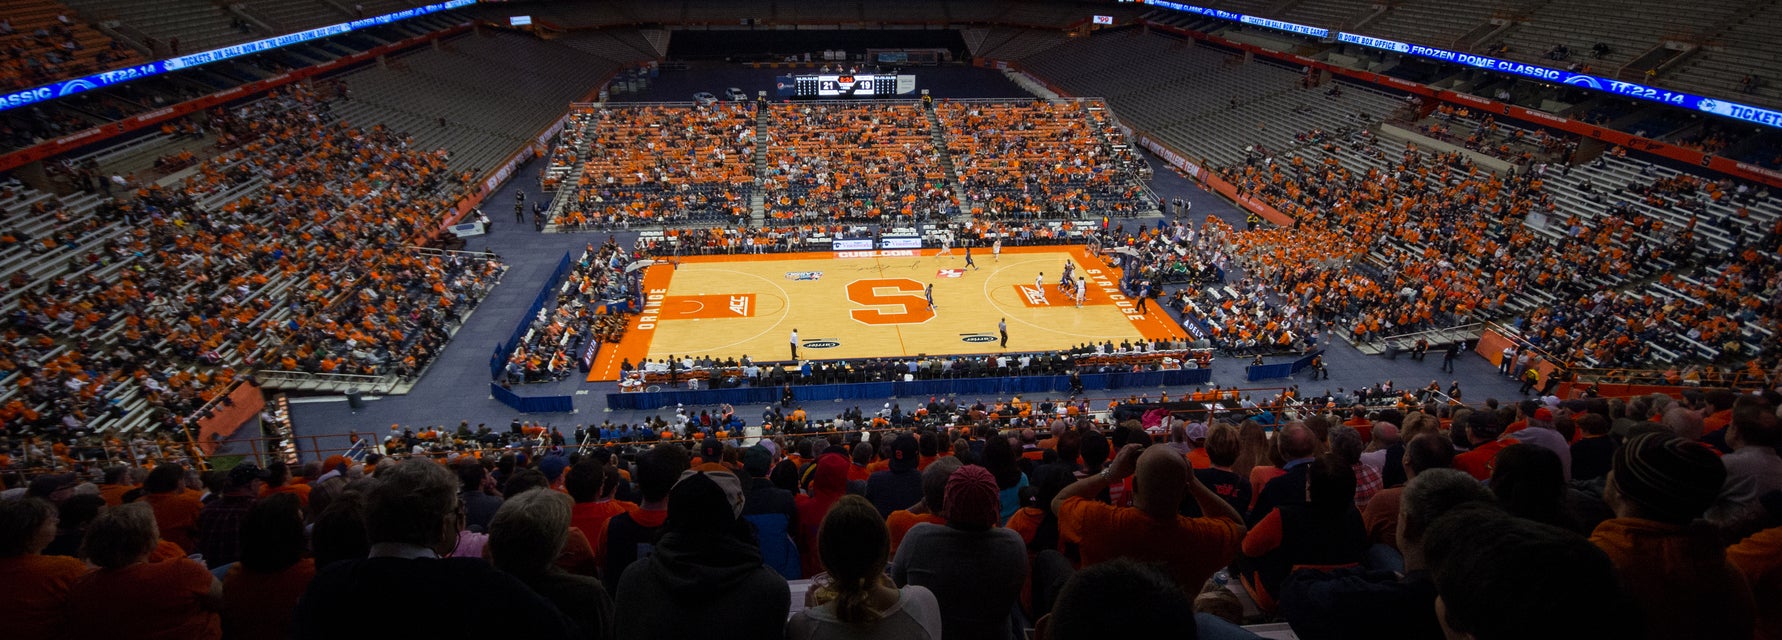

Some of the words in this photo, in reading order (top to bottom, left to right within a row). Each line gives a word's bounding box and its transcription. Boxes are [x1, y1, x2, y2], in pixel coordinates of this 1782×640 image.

[1344, 34, 1360, 43] DOME
[1361, 36, 1373, 45] BOX
[1375, 39, 1396, 50] OFFICE
[181, 52, 212, 66] TICKETS
[213, 50, 223, 60] ON
[224, 47, 241, 59] SALE
[1412, 45, 1456, 61] FROZEN
[1458, 54, 1495, 68] DOME
[1498, 61, 1560, 80] CLASSIC
[100, 64, 157, 85] 11.22.14
[823, 81, 834, 90] 21
[860, 81, 870, 90] 19
[1610, 81, 1685, 104] 11.22.14
[1701, 155, 1712, 167] S
[838, 249, 913, 258] CUSE.COM
[845, 278, 937, 326] S
[1087, 268, 1146, 321] SYRACUSE
[637, 287, 667, 331] ORANGE
[729, 295, 746, 316] ACC
